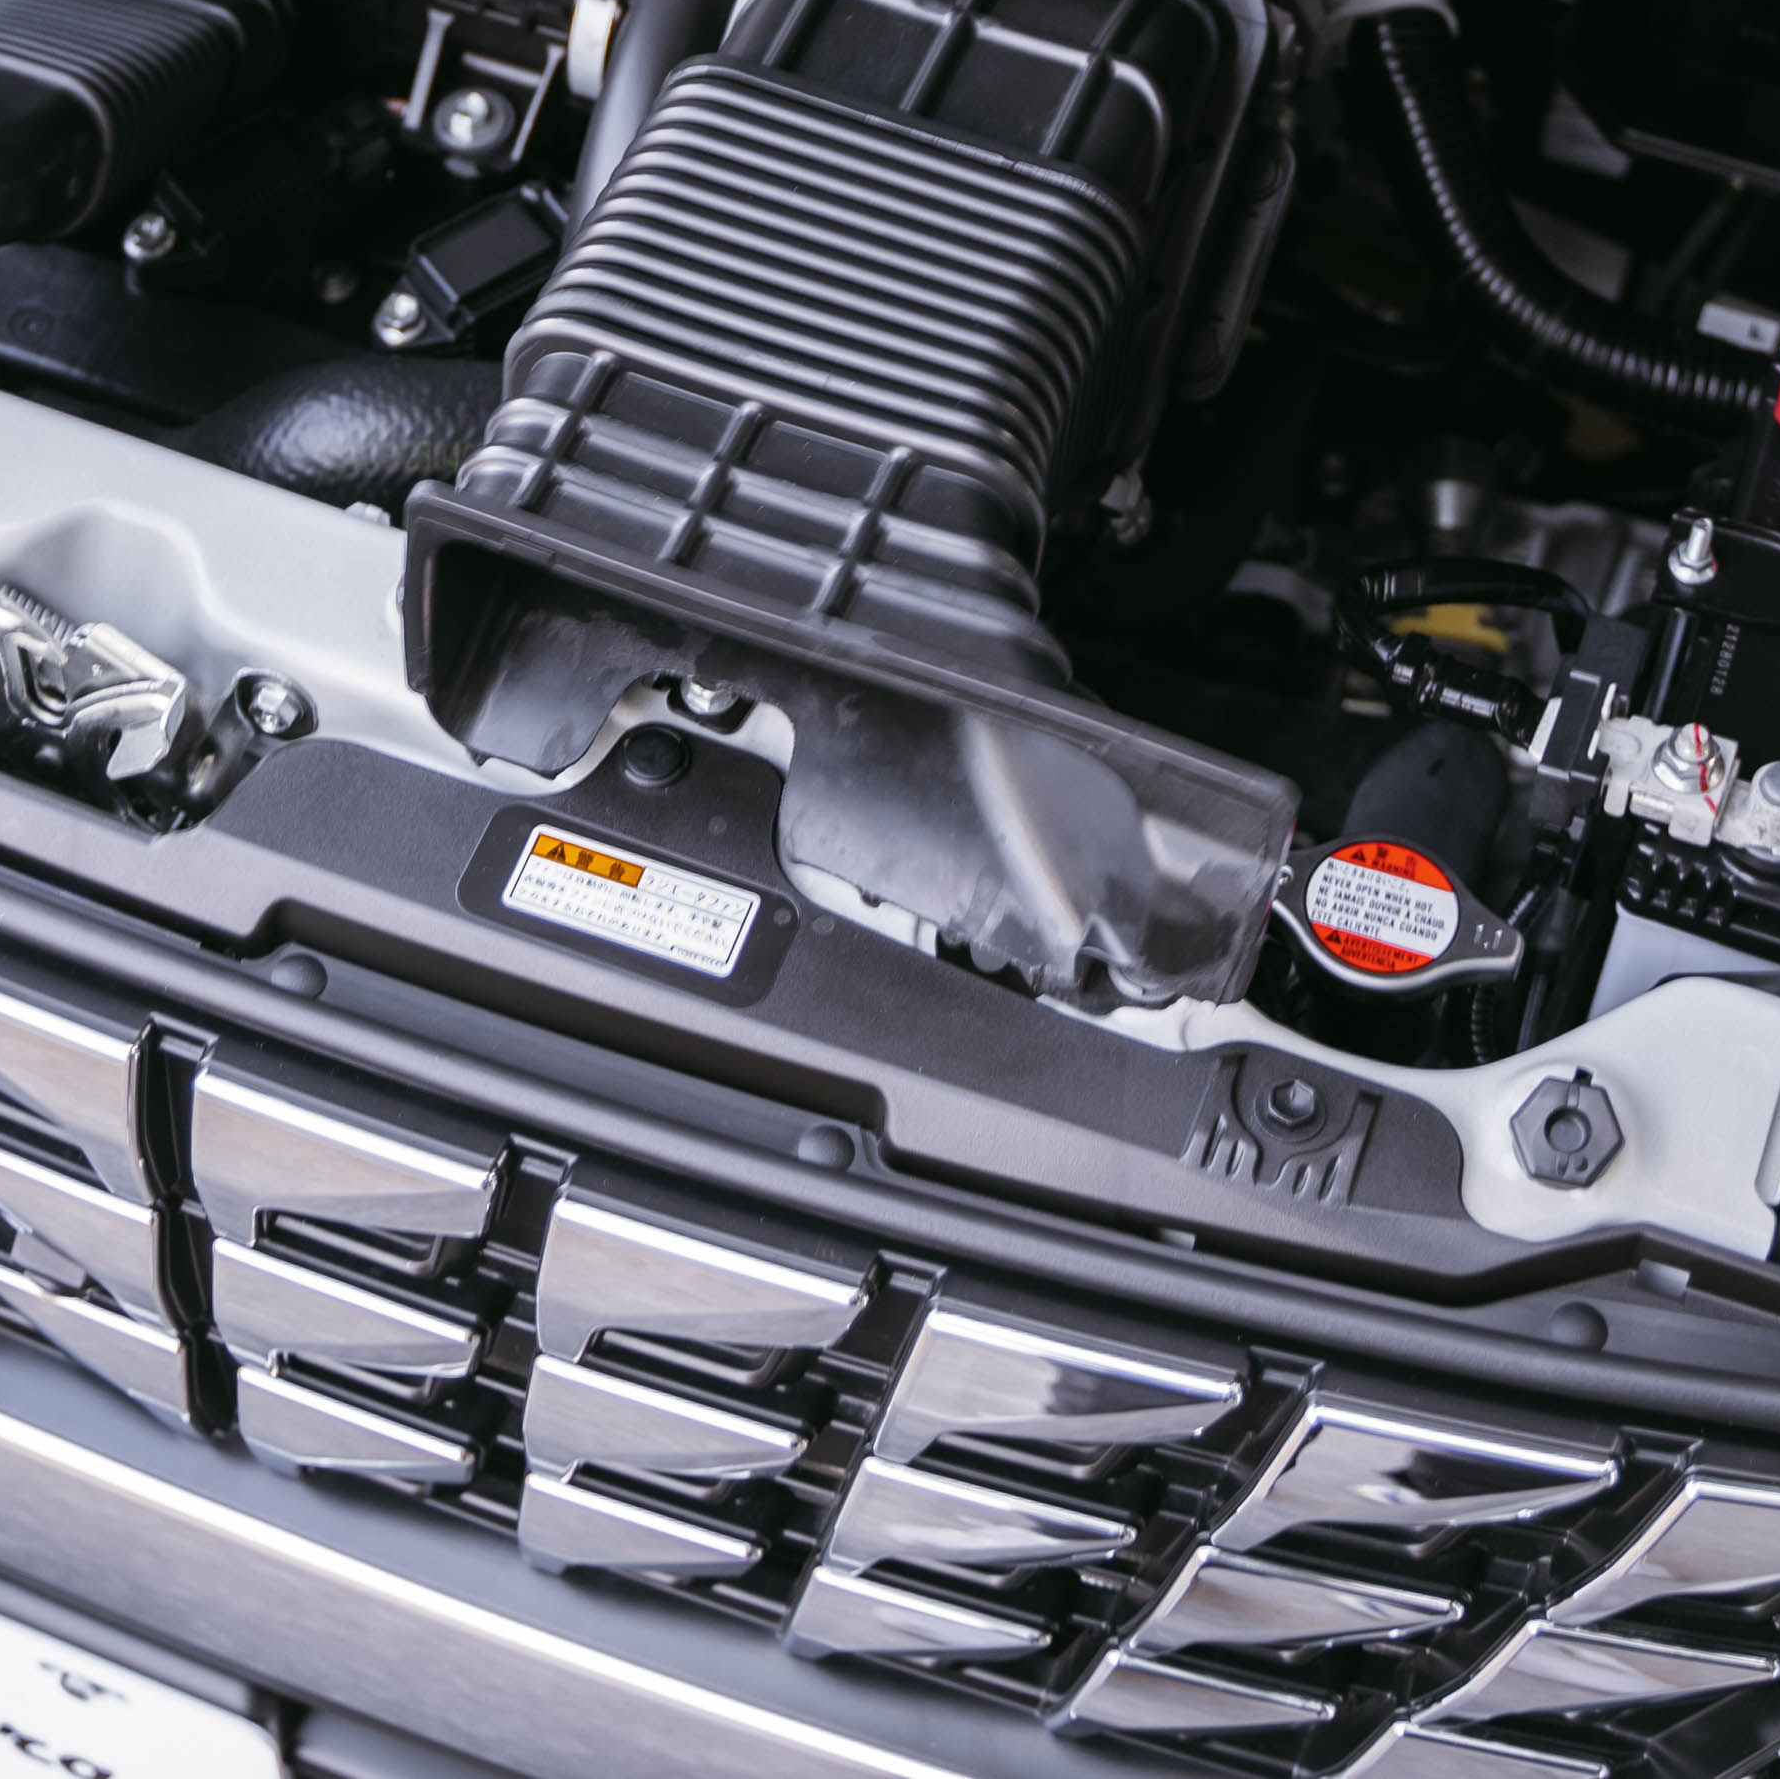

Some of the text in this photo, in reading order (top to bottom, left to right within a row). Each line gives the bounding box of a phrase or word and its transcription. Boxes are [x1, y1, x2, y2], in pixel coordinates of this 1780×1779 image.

[1317, 887, 1328, 897] NE
[1333, 891, 1365, 907] JAMAIS
[1368, 901, 1401, 916] OUVRIR
[1321, 874, 1351, 890] NEVER
[1355, 884, 1379, 898] OPEN
[1383, 892, 1411, 906] WHEN
[1313, 898, 1437, 940] NO ABRIR NUNCA CUANDO
